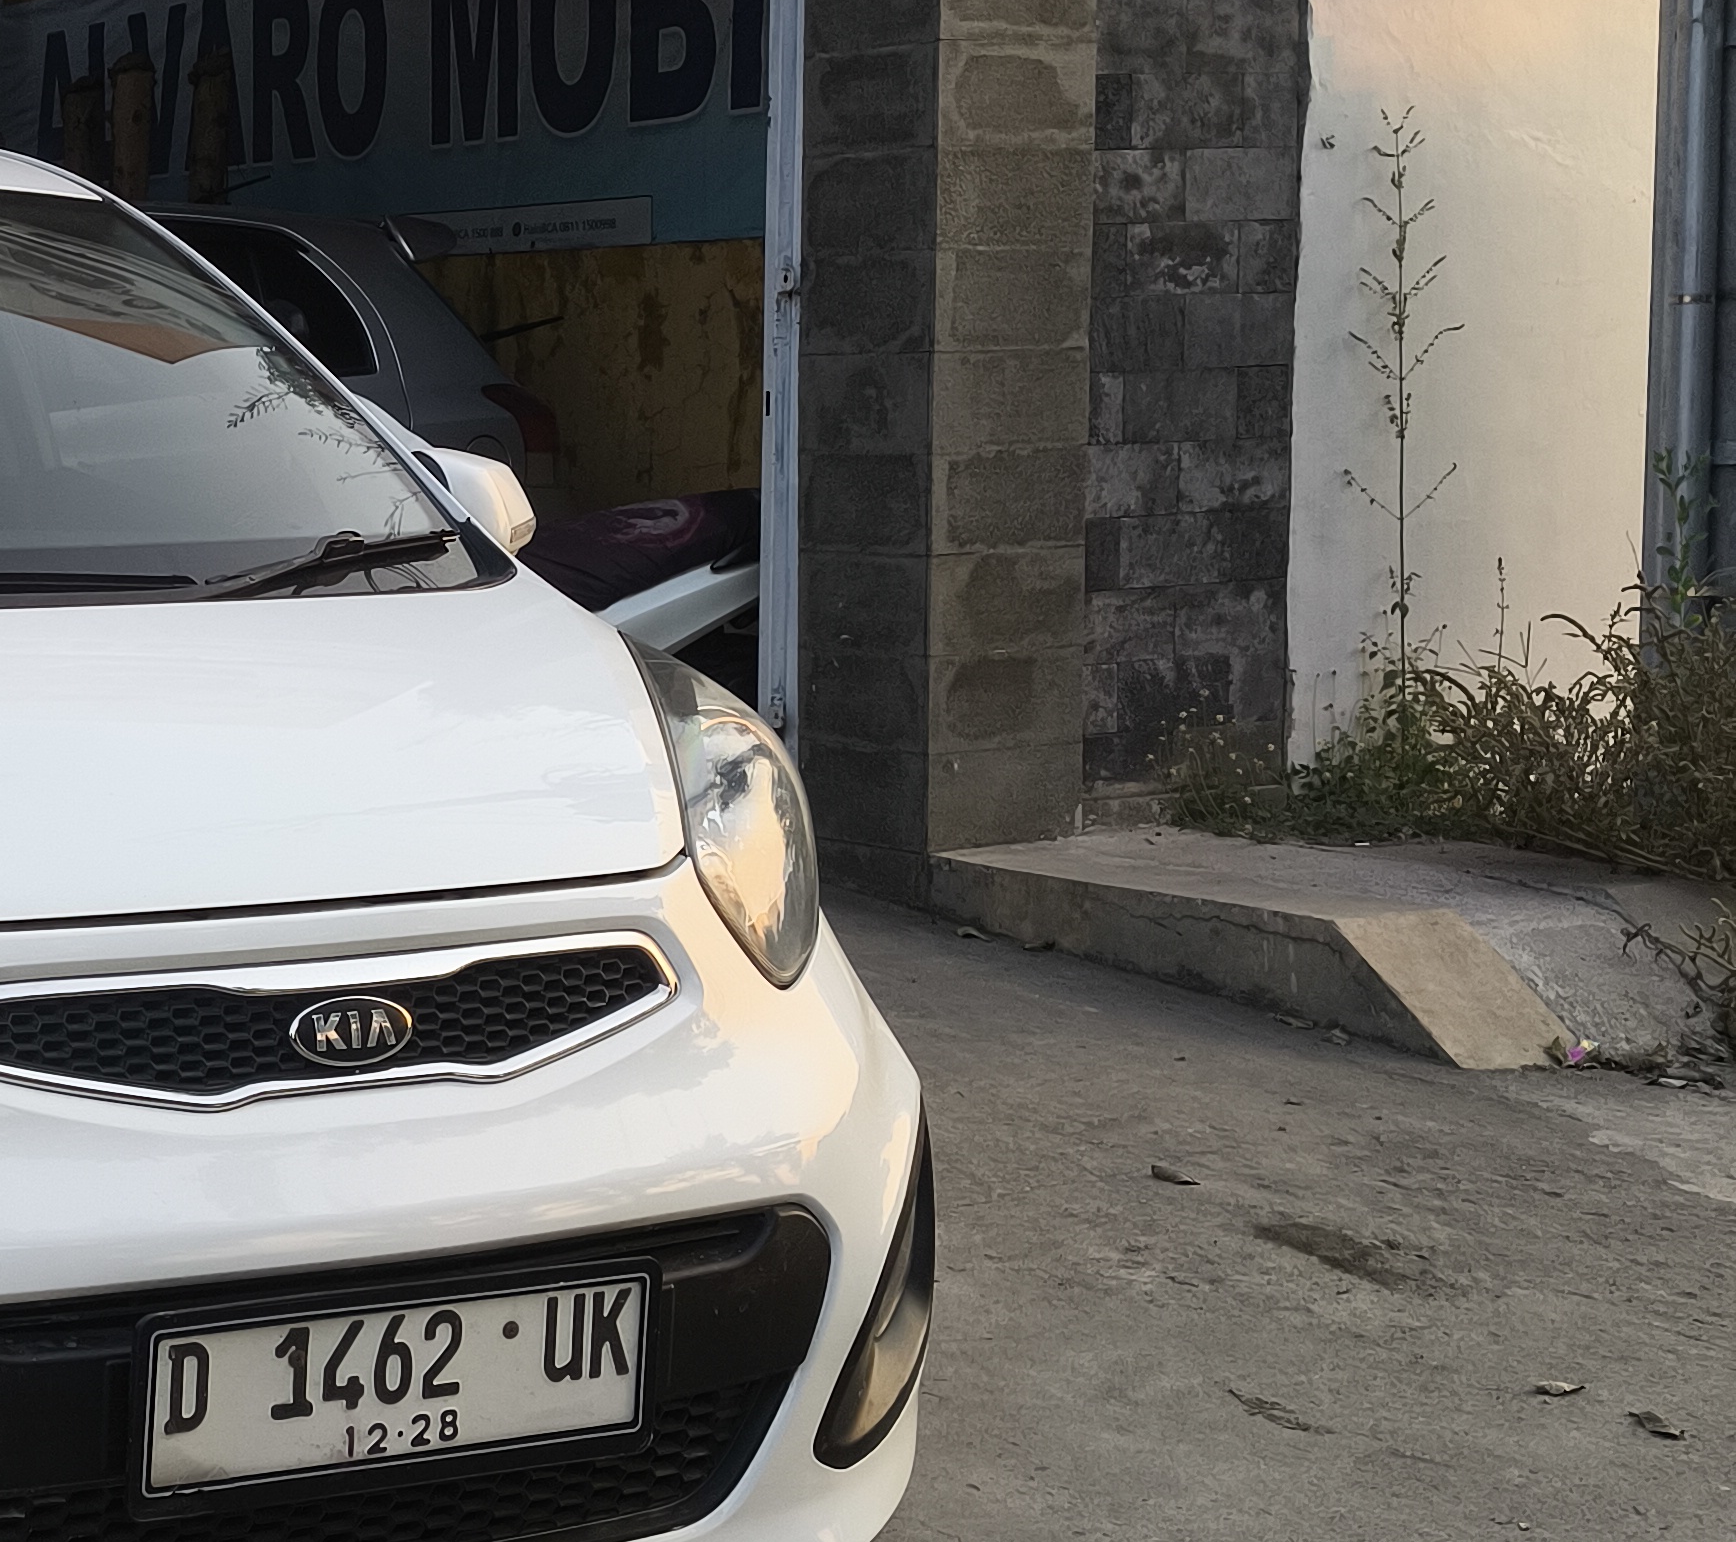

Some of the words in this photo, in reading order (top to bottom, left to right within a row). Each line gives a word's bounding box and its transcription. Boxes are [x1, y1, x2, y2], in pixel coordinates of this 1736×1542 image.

[310, 1008, 399, 1053] KIA
[163, 1341, 210, 1436] D
[269, 1308, 464, 1422] 1462
[543, 1286, 634, 1383] UK
